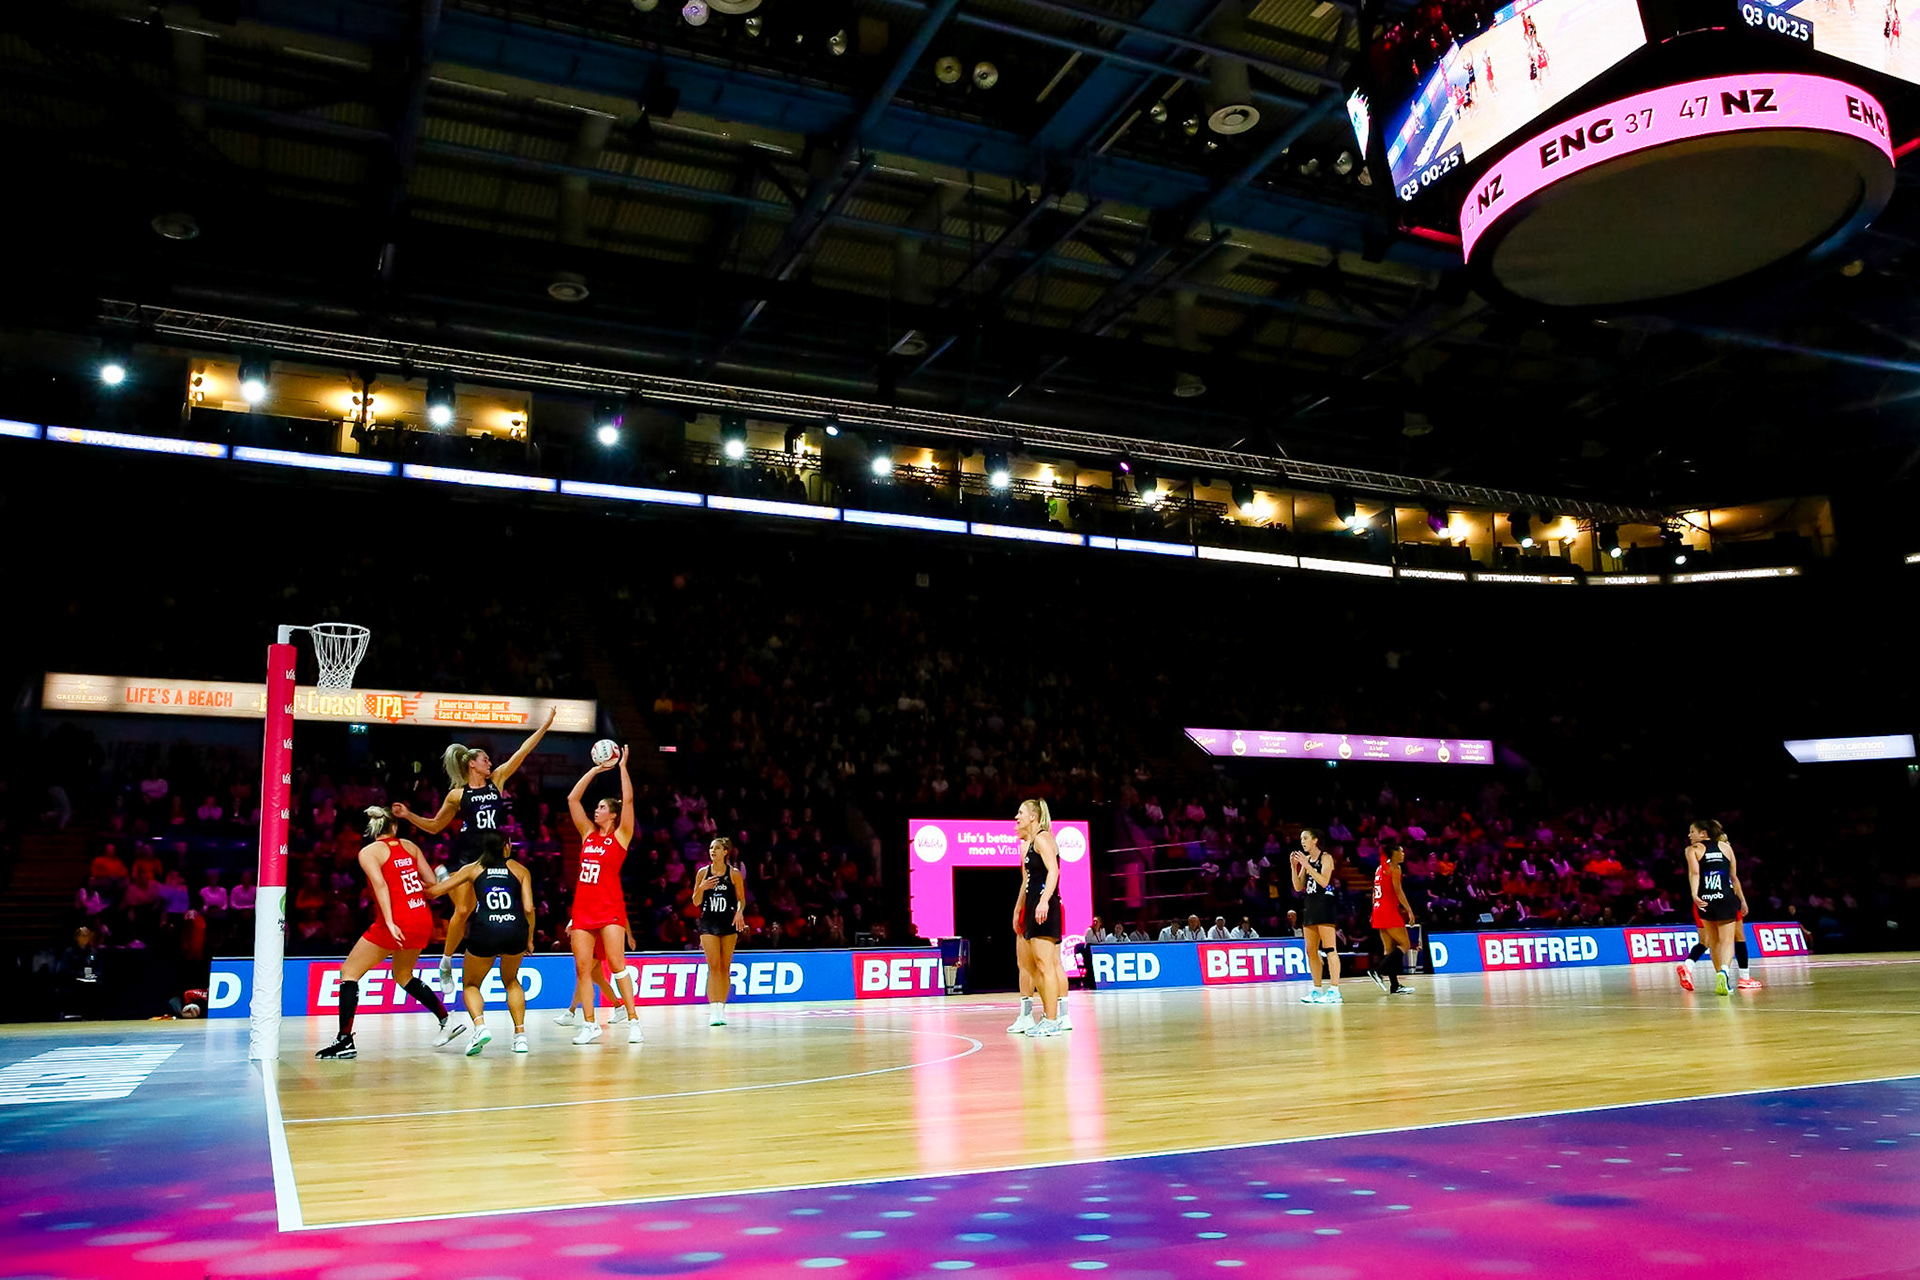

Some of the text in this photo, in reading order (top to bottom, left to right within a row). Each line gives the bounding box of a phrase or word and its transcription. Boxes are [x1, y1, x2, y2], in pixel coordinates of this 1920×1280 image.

[1742, 4, 1810, 42] Q3 00:25
[1538, 88, 1778, 169] ENG 37 47 NZ
[1400, 150, 1460, 201] Q3 00:25
[1477, 172, 1506, 216] NZ
[125, 686, 233, 708] LIFE'S A BEACH
[307, 690, 364, 717] Coast
[375, 695, 404, 719] IPA
[439, 700, 473, 710] American
[438, 711, 453, 720] East
[463, 712, 490, 722] England
[491, 714, 523, 723] Brewing
[470, 791, 498, 803] myob
[475, 809, 497, 830] GK
[957, 832, 1018, 844] Life's better
[968, 844, 1021, 856] more Vital
[579, 861, 601, 884] GA
[1704, 874, 1723, 891] WA
[401, 870, 424, 896] GS
[486, 891, 512, 910] GD
[709, 896, 728, 912] WD
[1701, 892, 1724, 902] myob
[489, 913, 517, 924] myob
[1484, 935, 1599, 966] BETFRED
